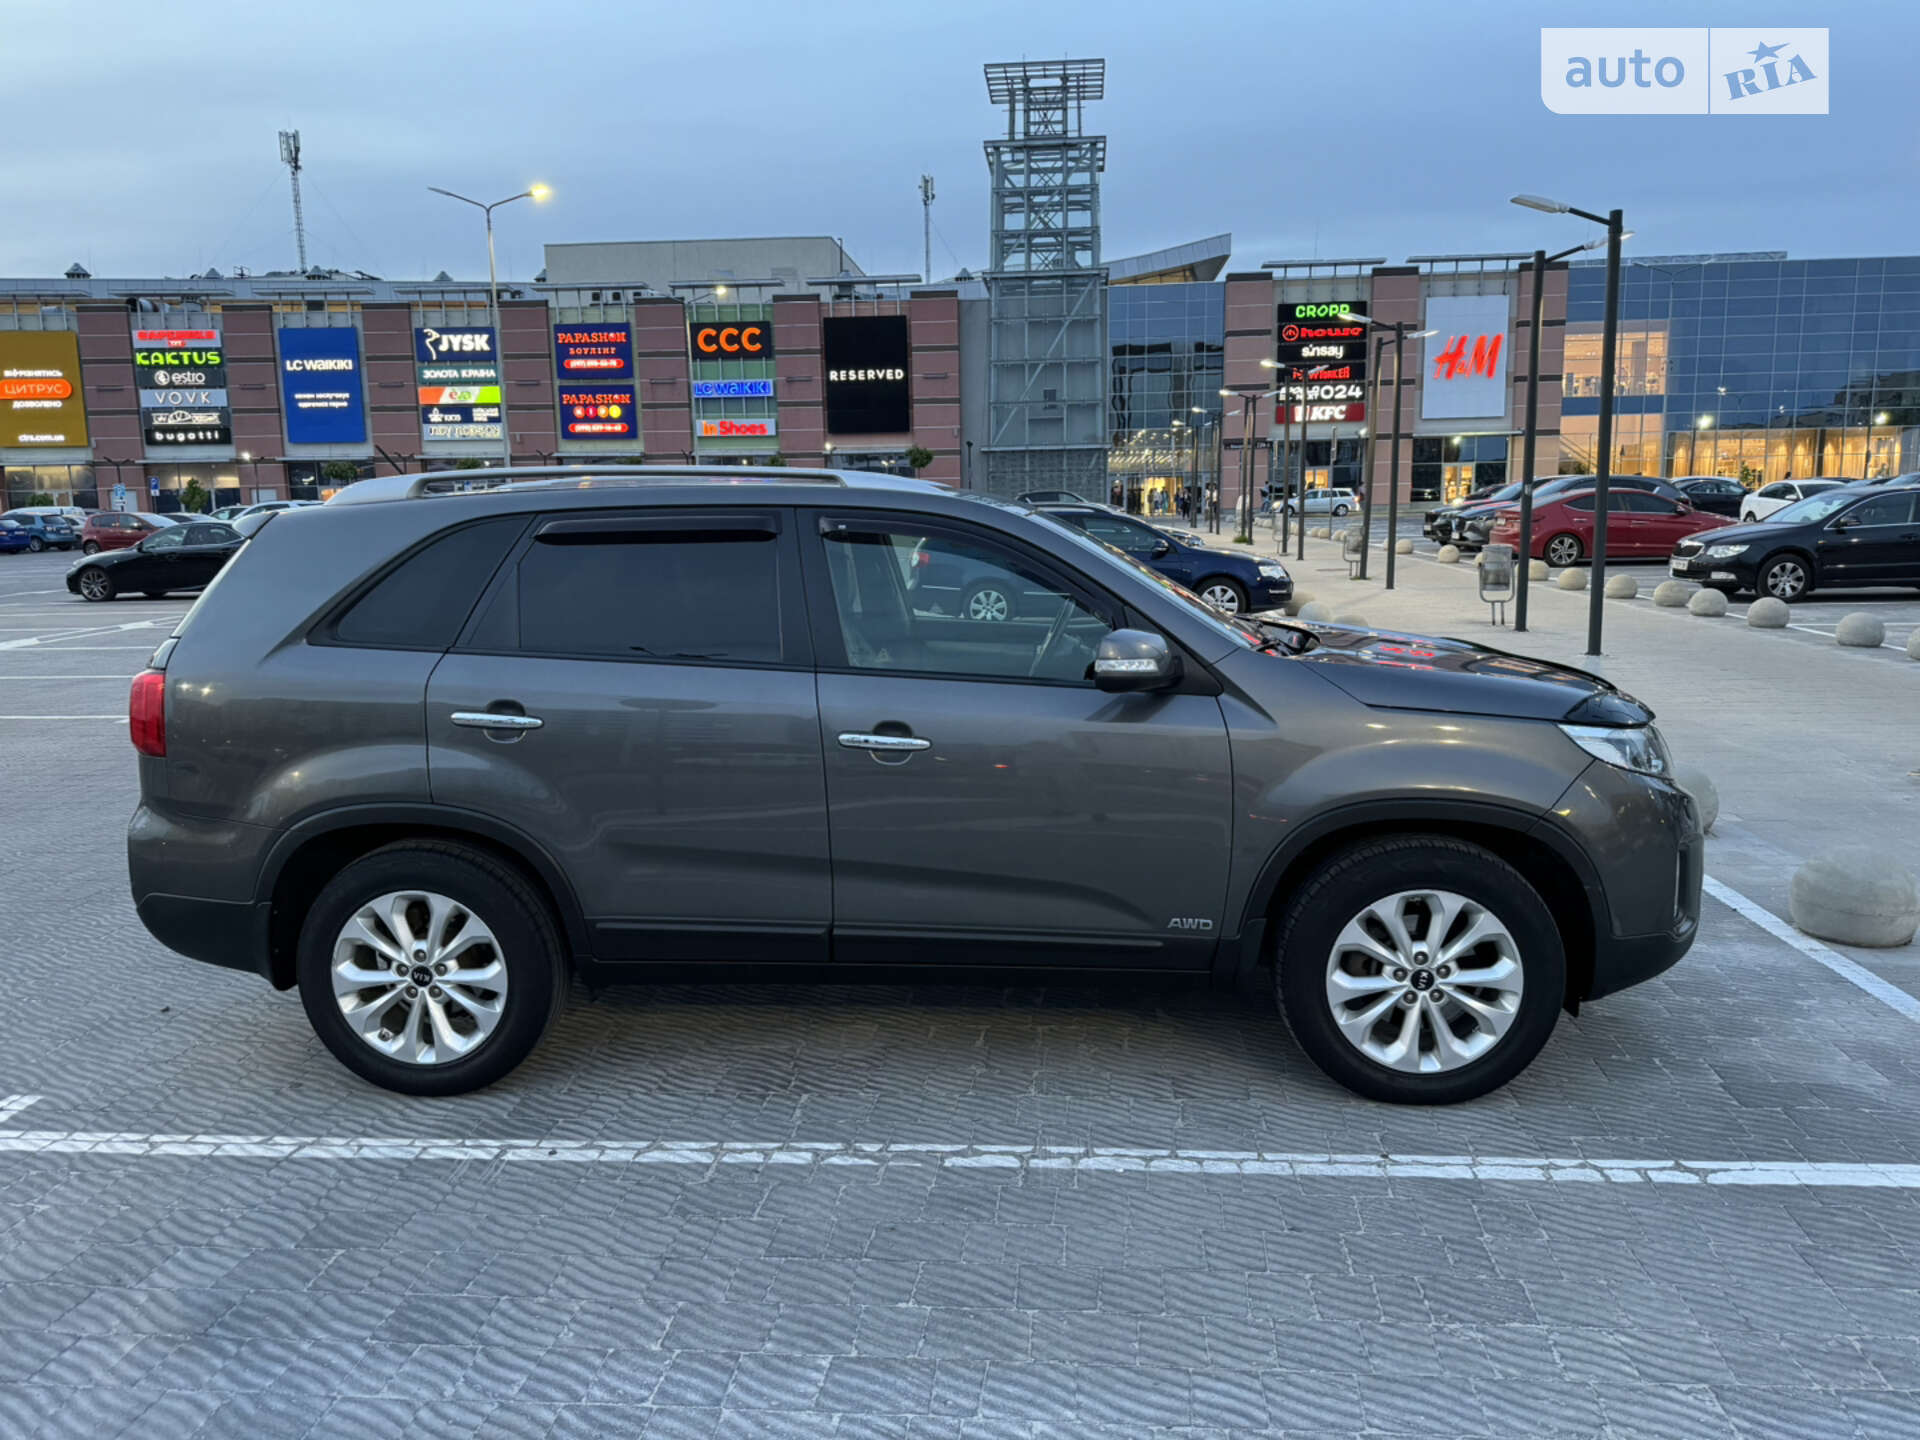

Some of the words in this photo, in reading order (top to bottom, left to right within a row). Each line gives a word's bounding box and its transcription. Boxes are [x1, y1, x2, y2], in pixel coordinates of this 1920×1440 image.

[1296, 304, 1350, 318] CROPP
[438, 334, 492, 352] JYSK
[557, 332, 627, 344] PAPASHON
[697, 327, 762, 353] CCC
[1301, 344, 1344, 359] sinsay
[1433, 333, 1504, 379] H&M
[286, 359, 303, 371] LC
[171, 371, 206, 383] estro
[829, 369, 904, 381] RESERVED
[5, 383, 63, 395] ЦИТРУС
[695, 383, 712, 396] LC
[154, 391, 211, 405] VOVK
[1310, 405, 1347, 421] KFC
[154, 431, 220, 442] bugatti
[1167, 918, 1213, 930] AWD
